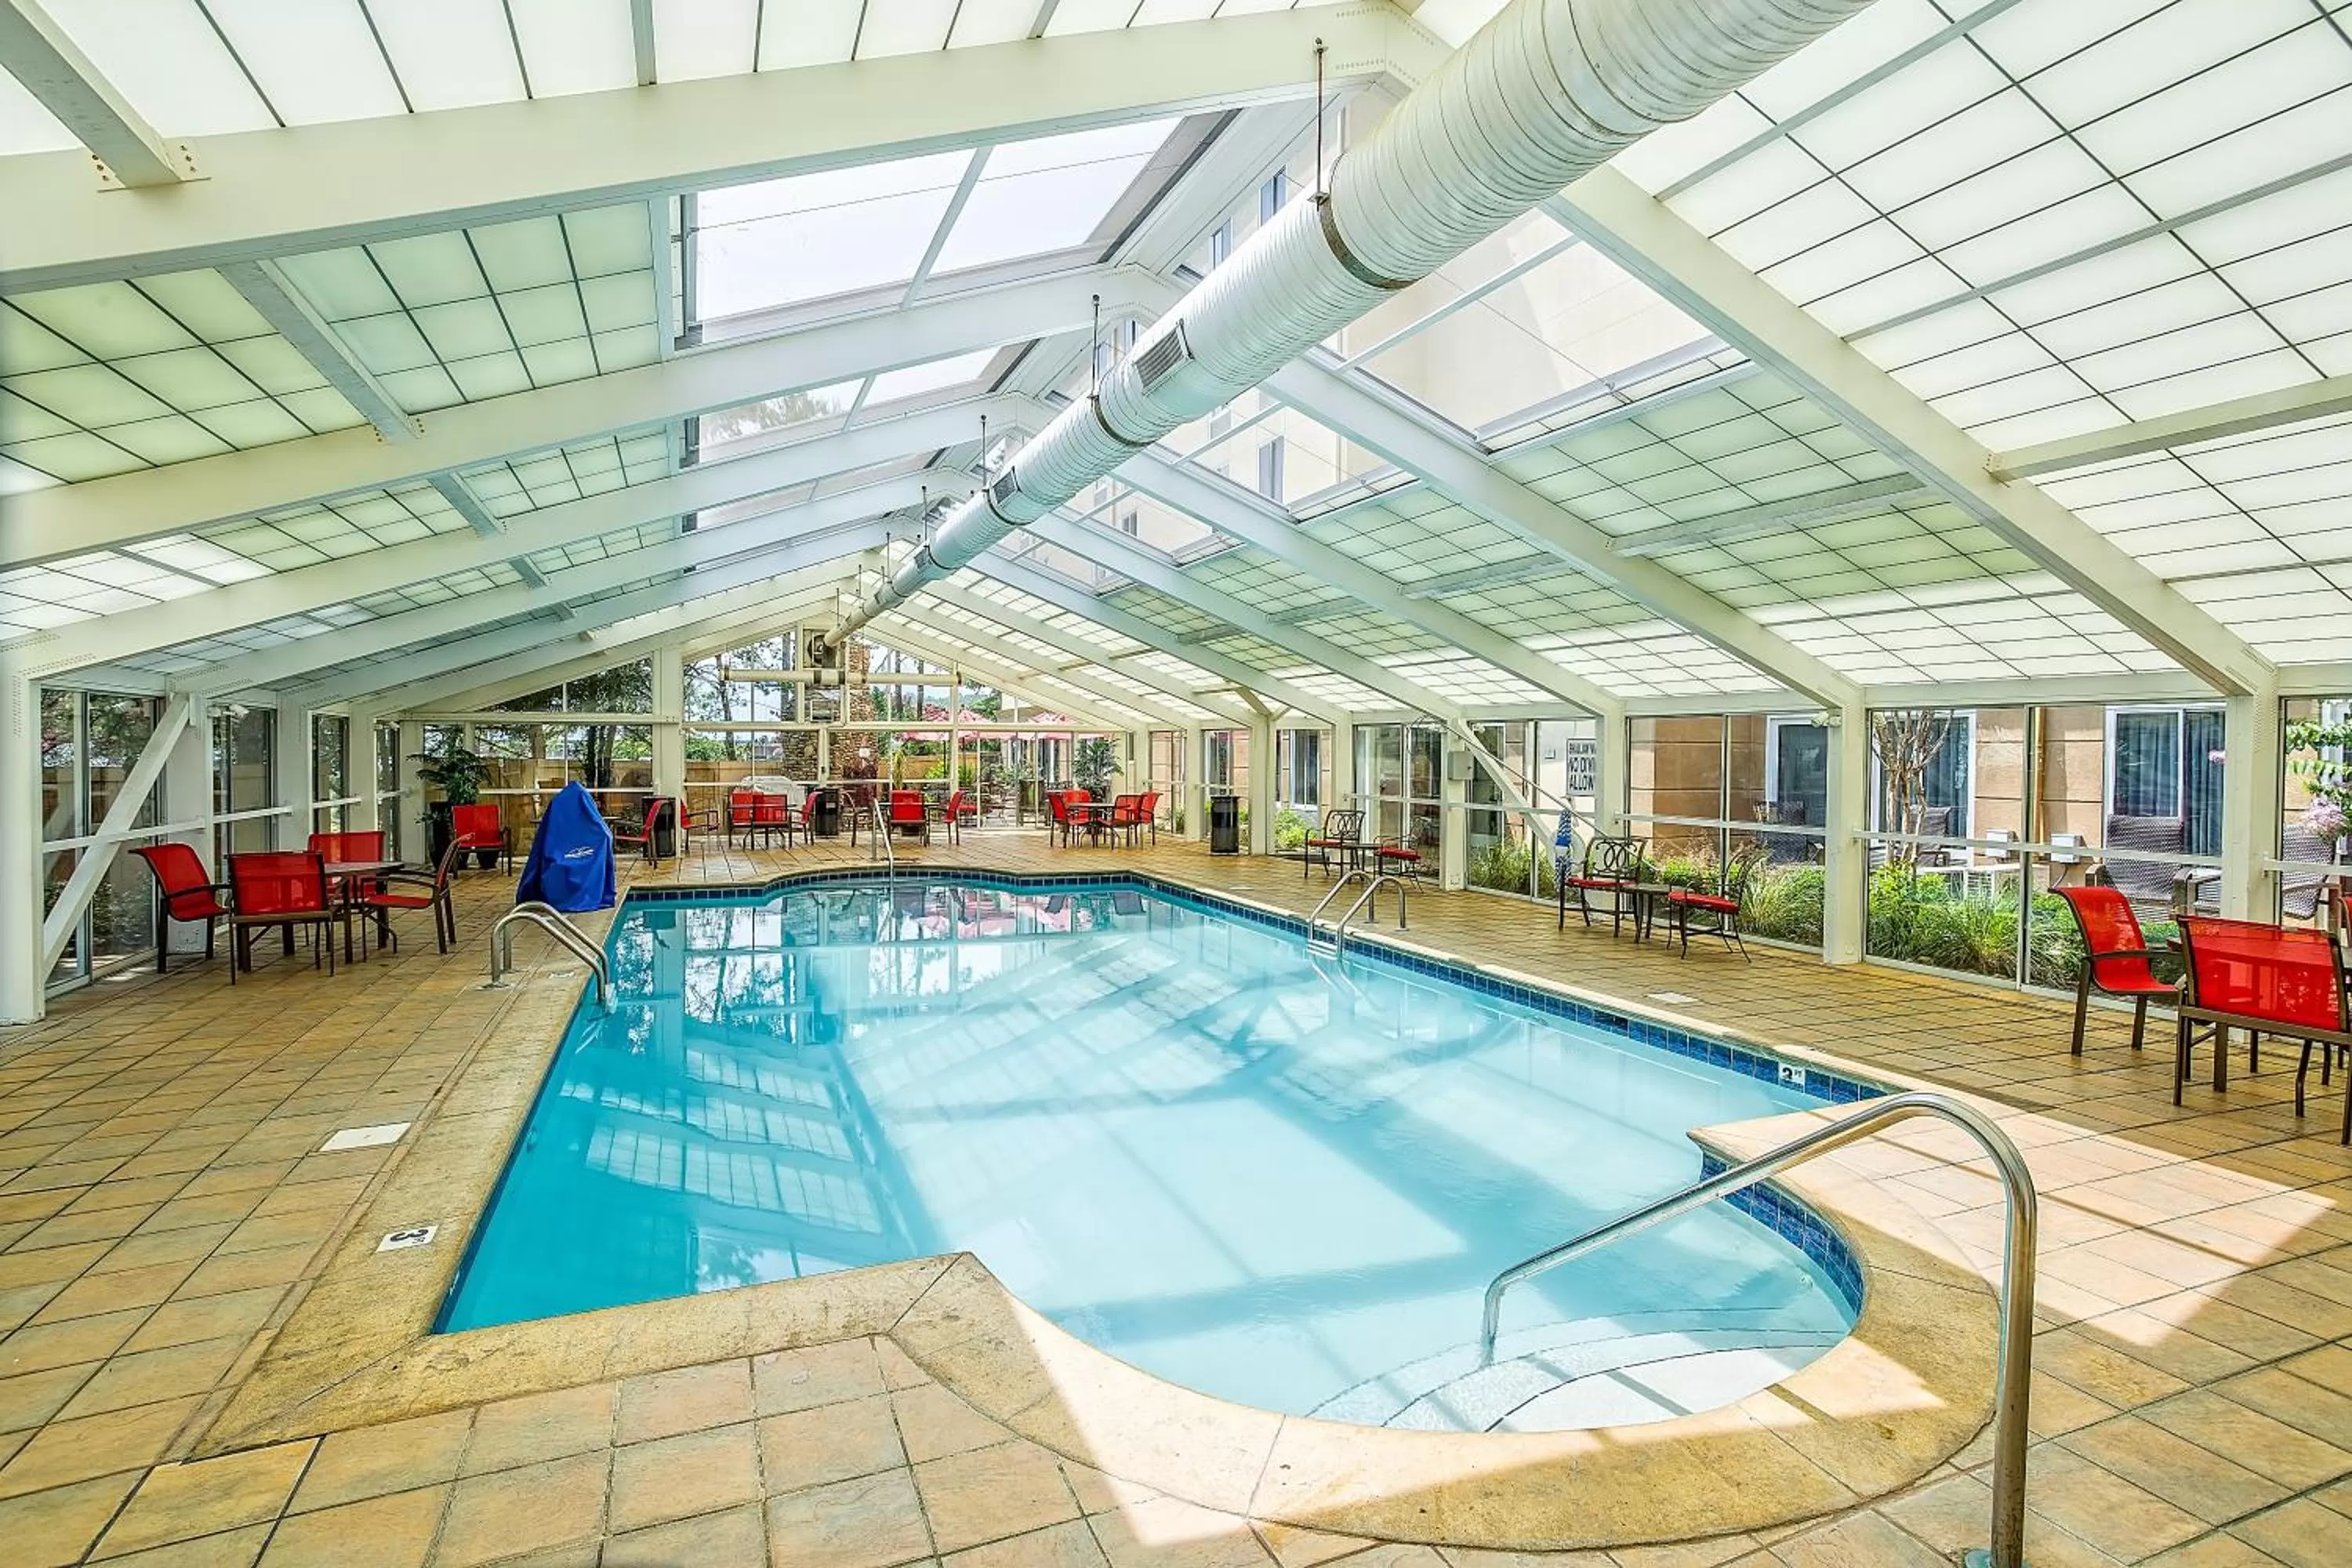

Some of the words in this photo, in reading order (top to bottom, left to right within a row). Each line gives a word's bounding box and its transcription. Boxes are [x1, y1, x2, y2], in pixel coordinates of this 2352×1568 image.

[1569, 757, 1578, 772] NO
[1569, 774, 1597, 791] ALLOW
[390, 1229, 429, 1242] 3
